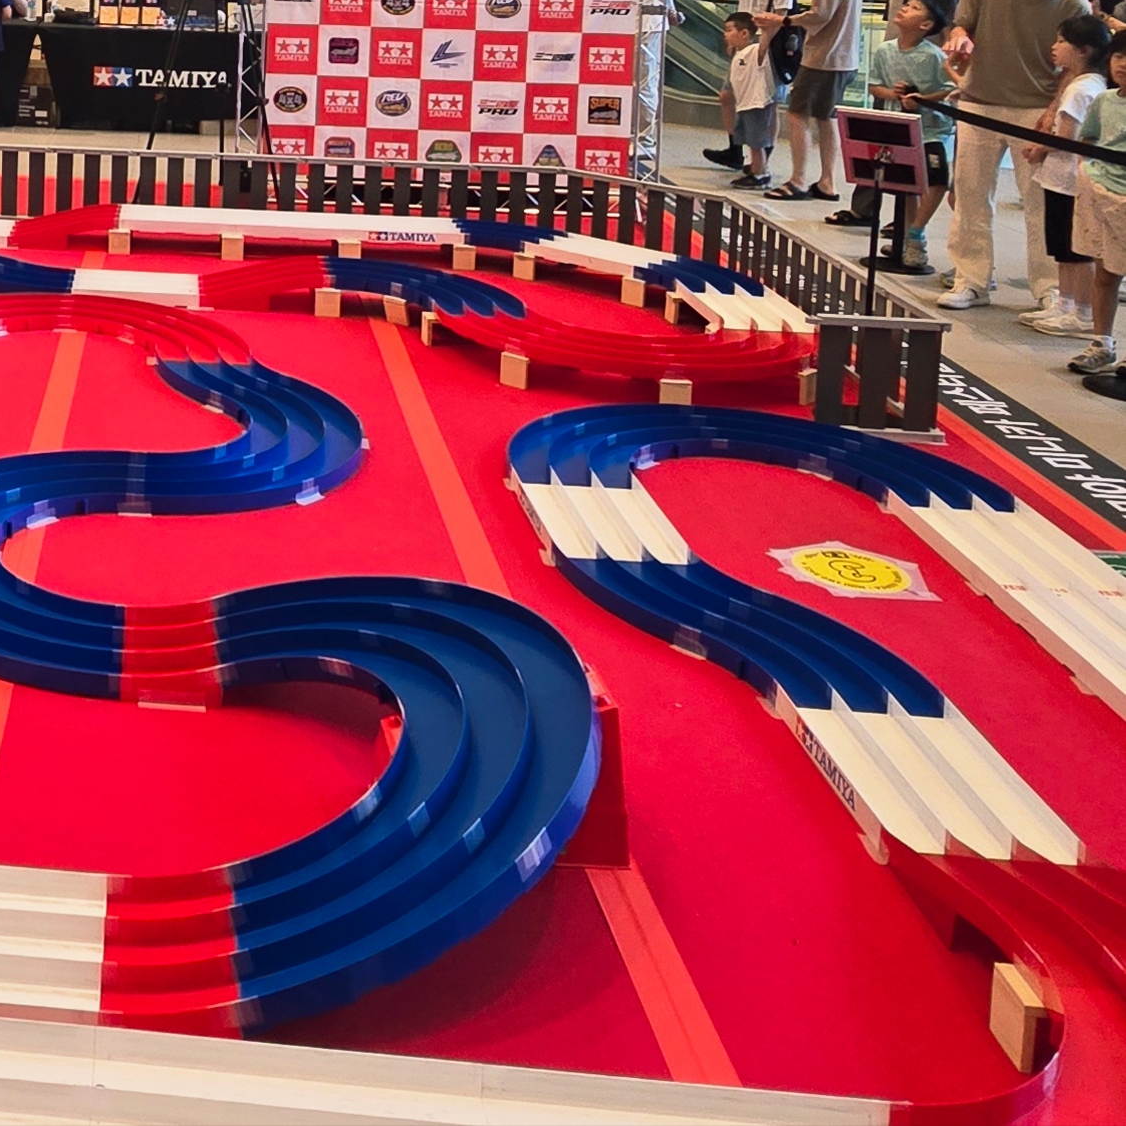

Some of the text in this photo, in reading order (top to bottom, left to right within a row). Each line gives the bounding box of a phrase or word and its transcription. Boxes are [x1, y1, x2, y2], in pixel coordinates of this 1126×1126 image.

[329, 5, 363, 13] TAMIYA
[433, 8, 467, 16] TAMIYA
[590, 8, 630, 16] PRO
[275, 54, 309, 62] TAMIYA
[378, 58, 412, 66] TAMIYA
[483, 61, 517, 69] TAMIYA
[588, 64, 624, 72] TAMIYA
[590, 98, 619, 110] SUPER
[325, 106, 358, 114] TAMIYA
[428, 110, 462, 118] TAMIYA
[389, 231, 435, 242] TAMIYA
[814, 740, 856, 812] TAMIYA
